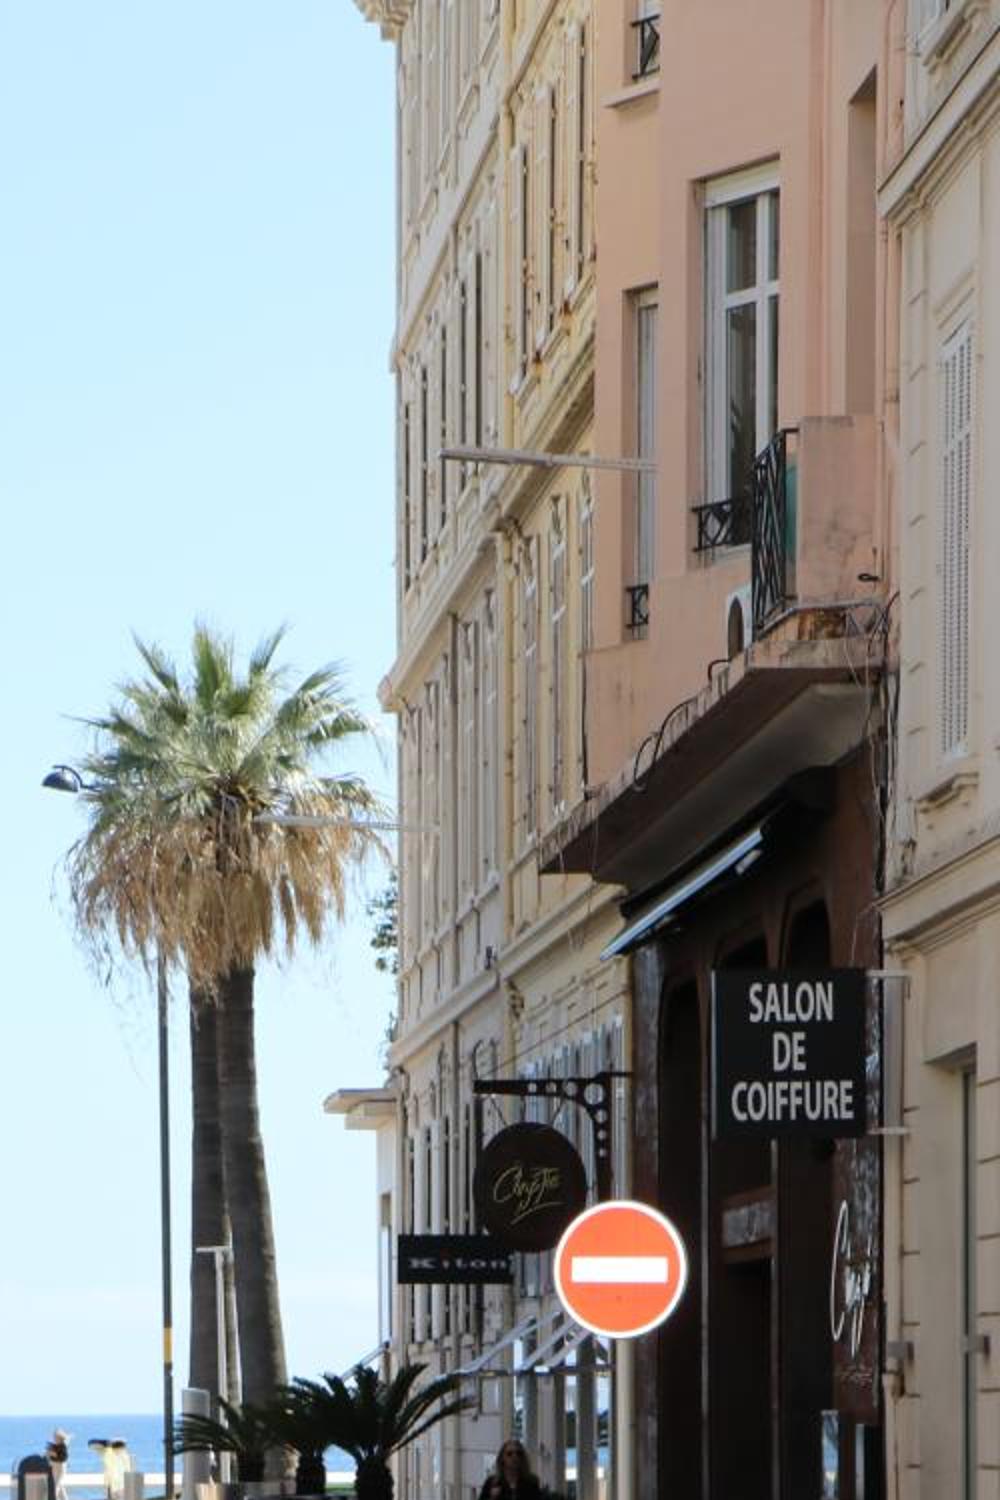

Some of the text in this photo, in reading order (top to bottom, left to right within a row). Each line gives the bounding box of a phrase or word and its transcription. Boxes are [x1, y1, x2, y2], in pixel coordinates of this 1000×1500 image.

[749, 981, 833, 1023] SALON
[773, 1031, 807, 1072] DE
[731, 1080, 854, 1122] COIFFURE
